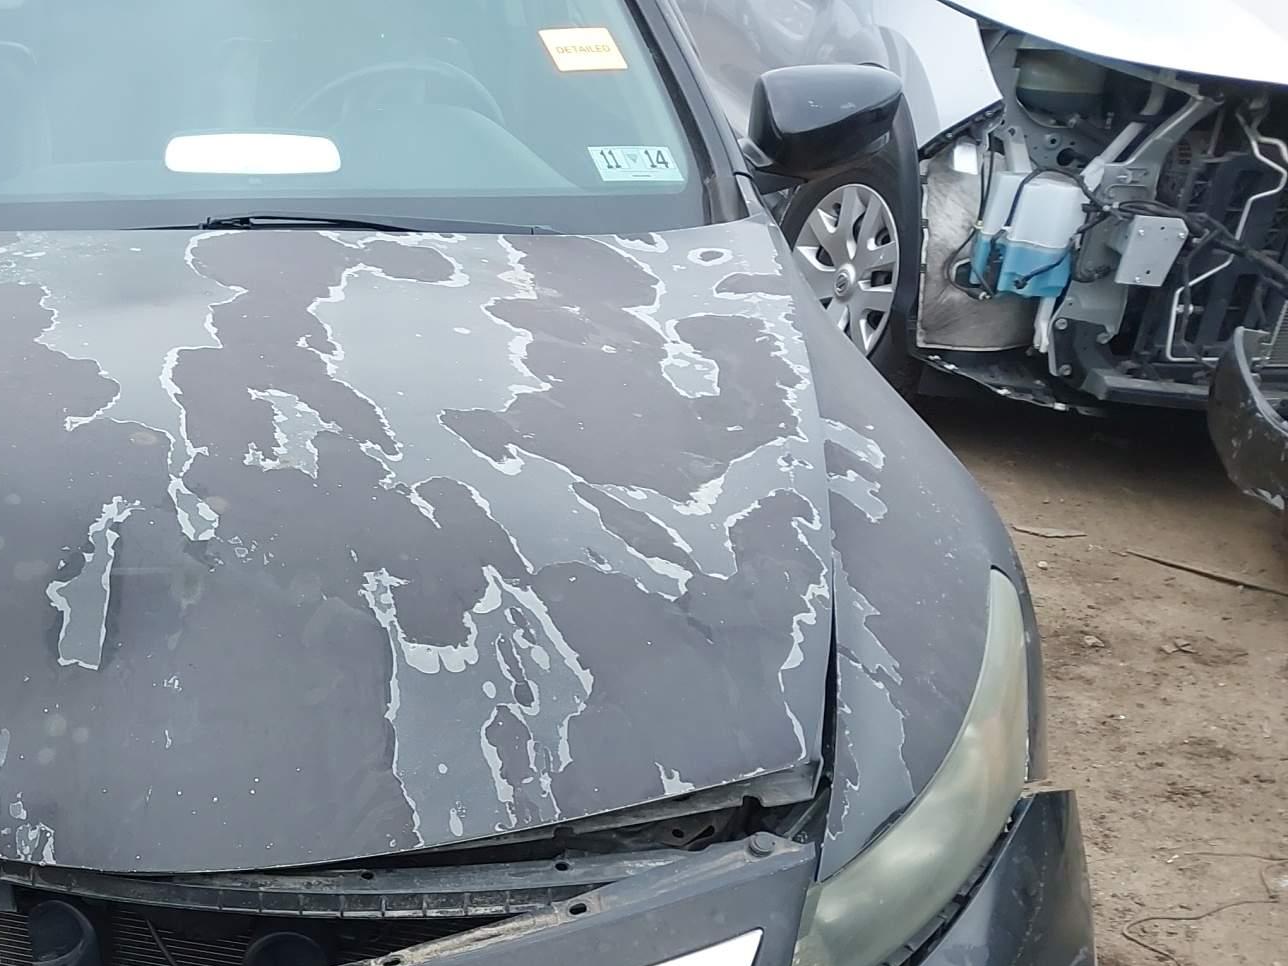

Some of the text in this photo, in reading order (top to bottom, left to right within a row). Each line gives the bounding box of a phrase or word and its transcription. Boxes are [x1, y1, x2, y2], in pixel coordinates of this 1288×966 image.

[555, 44, 611, 54] DETAILED
[600, 149, 669, 169] 11 14
